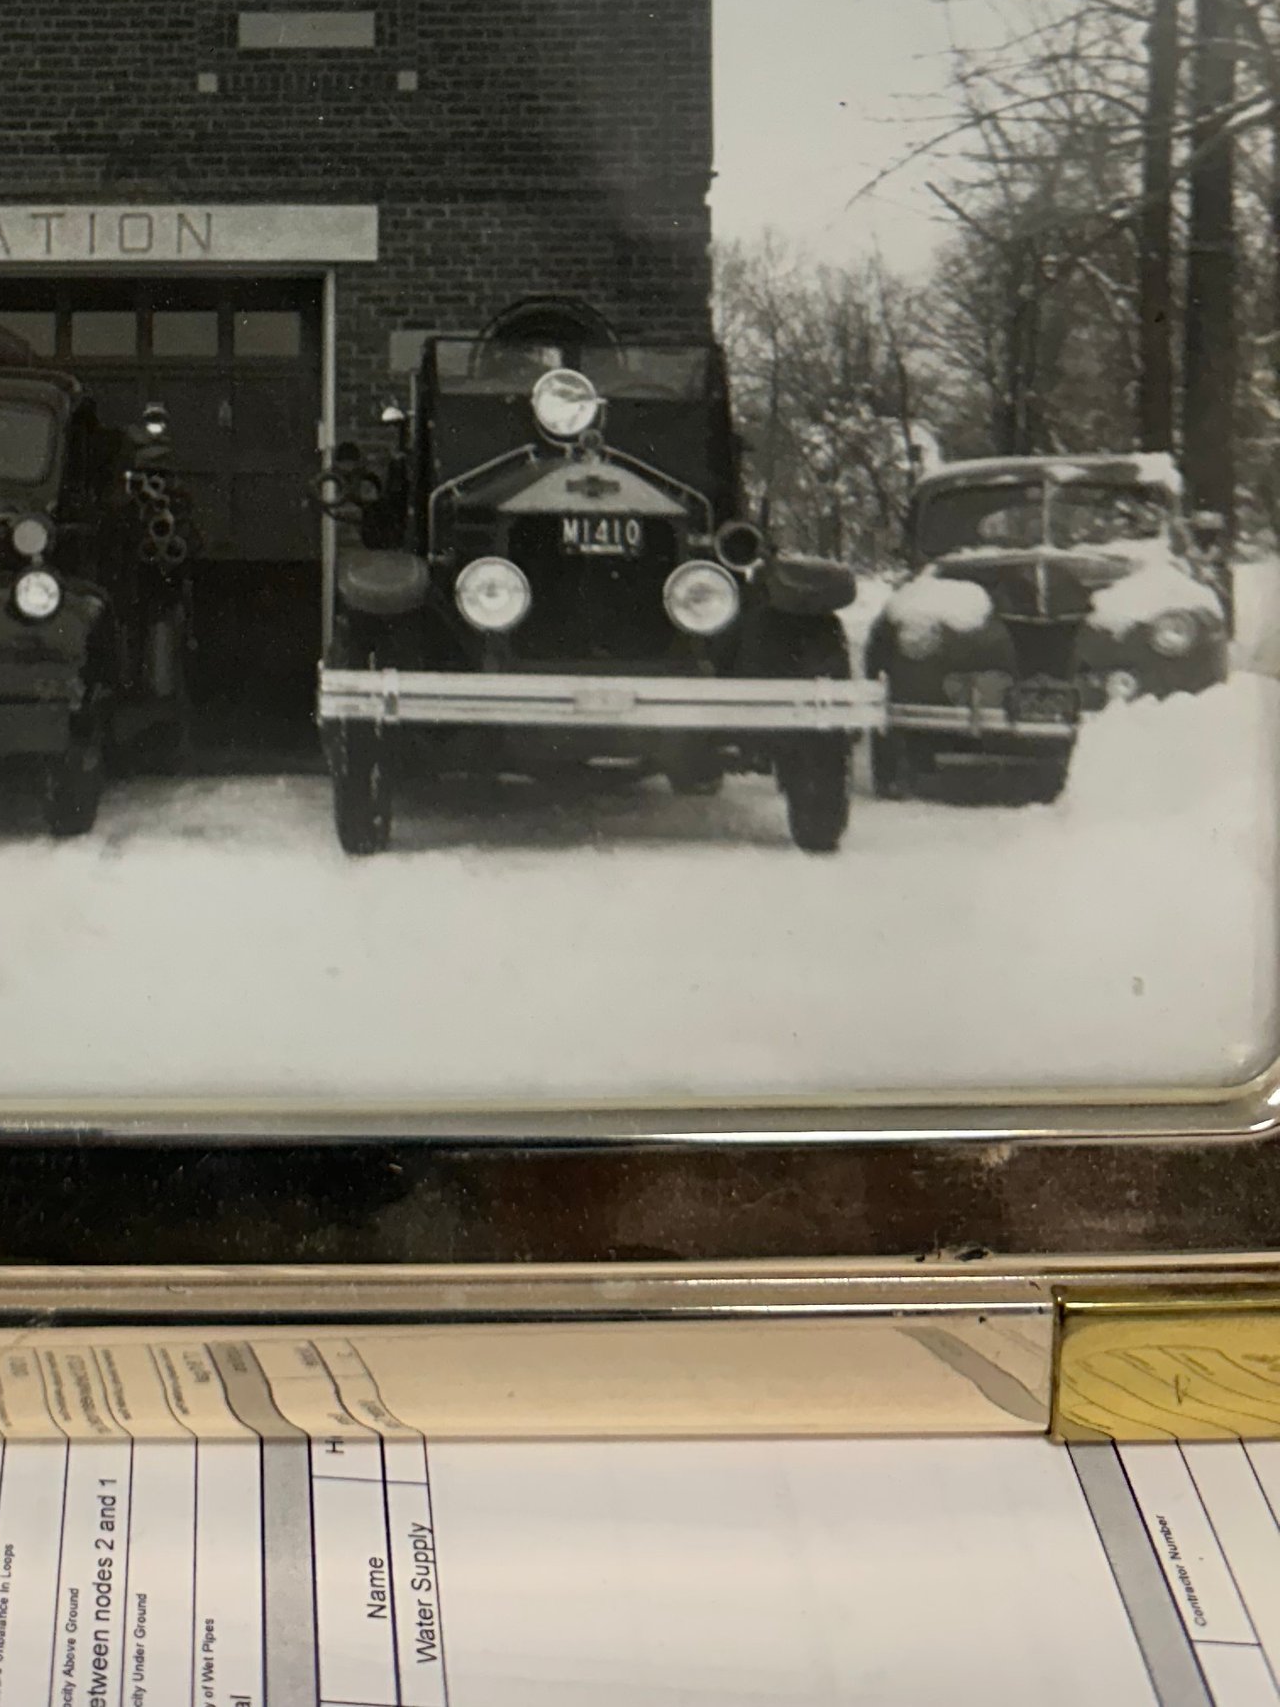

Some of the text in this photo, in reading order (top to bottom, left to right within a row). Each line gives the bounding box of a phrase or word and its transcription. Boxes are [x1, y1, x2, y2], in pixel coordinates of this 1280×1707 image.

[98, 1477, 117, 1487] 1
[97, 1494, 117, 1532] and
[0, 1543, 16, 1579] Loops
[94, 1537, 115, 1551] 2
[92, 1556, 113, 1623] nodes
[366, 1556, 388, 1620] Name
[1156, 1514, 1207, 1627] Contractor Number
[65, 1587, 79, 1634] Ground
[407, 1521, 438, 1664] Water Supply
[133, 1593, 147, 1640] Ground
[201, 1617, 217, 1653] Pipes
[62, 1637, 76, 1678] Above
[132, 1641, 145, 1683] Under
[201, 1656, 215, 1683] Wet
[201, 1685, 214, 1698] of
